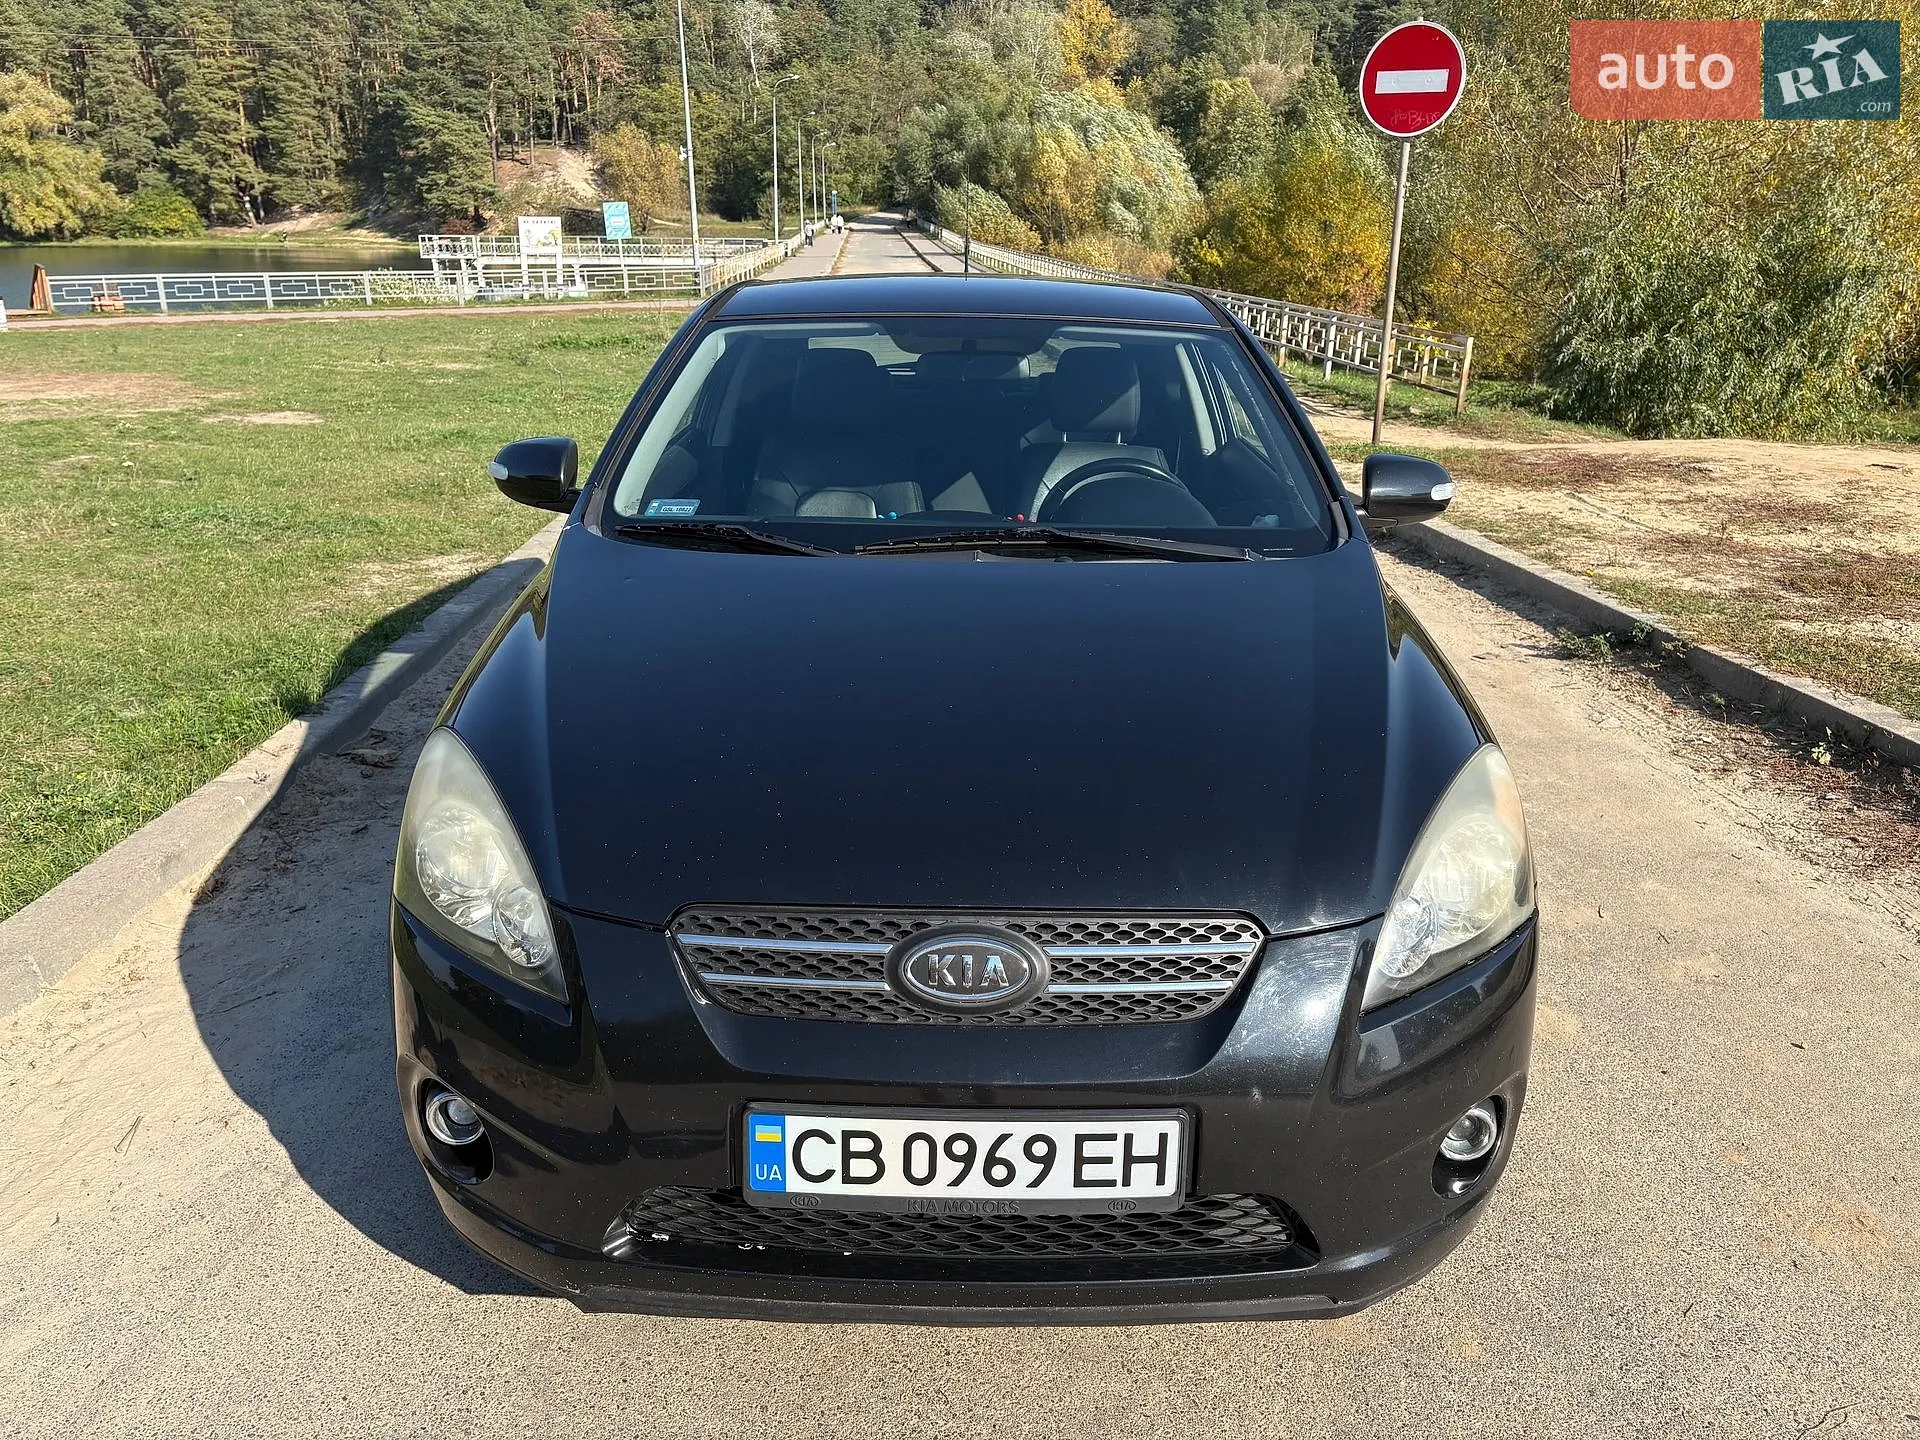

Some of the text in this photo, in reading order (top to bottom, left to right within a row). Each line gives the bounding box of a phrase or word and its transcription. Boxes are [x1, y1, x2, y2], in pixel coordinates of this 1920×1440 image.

[928, 954, 1009, 988] KIA
[792, 1128, 1169, 1188] CB 0969 EH
[755, 1164, 783, 1182] UA
[907, 1199, 1021, 1215] KIA MOTORS
